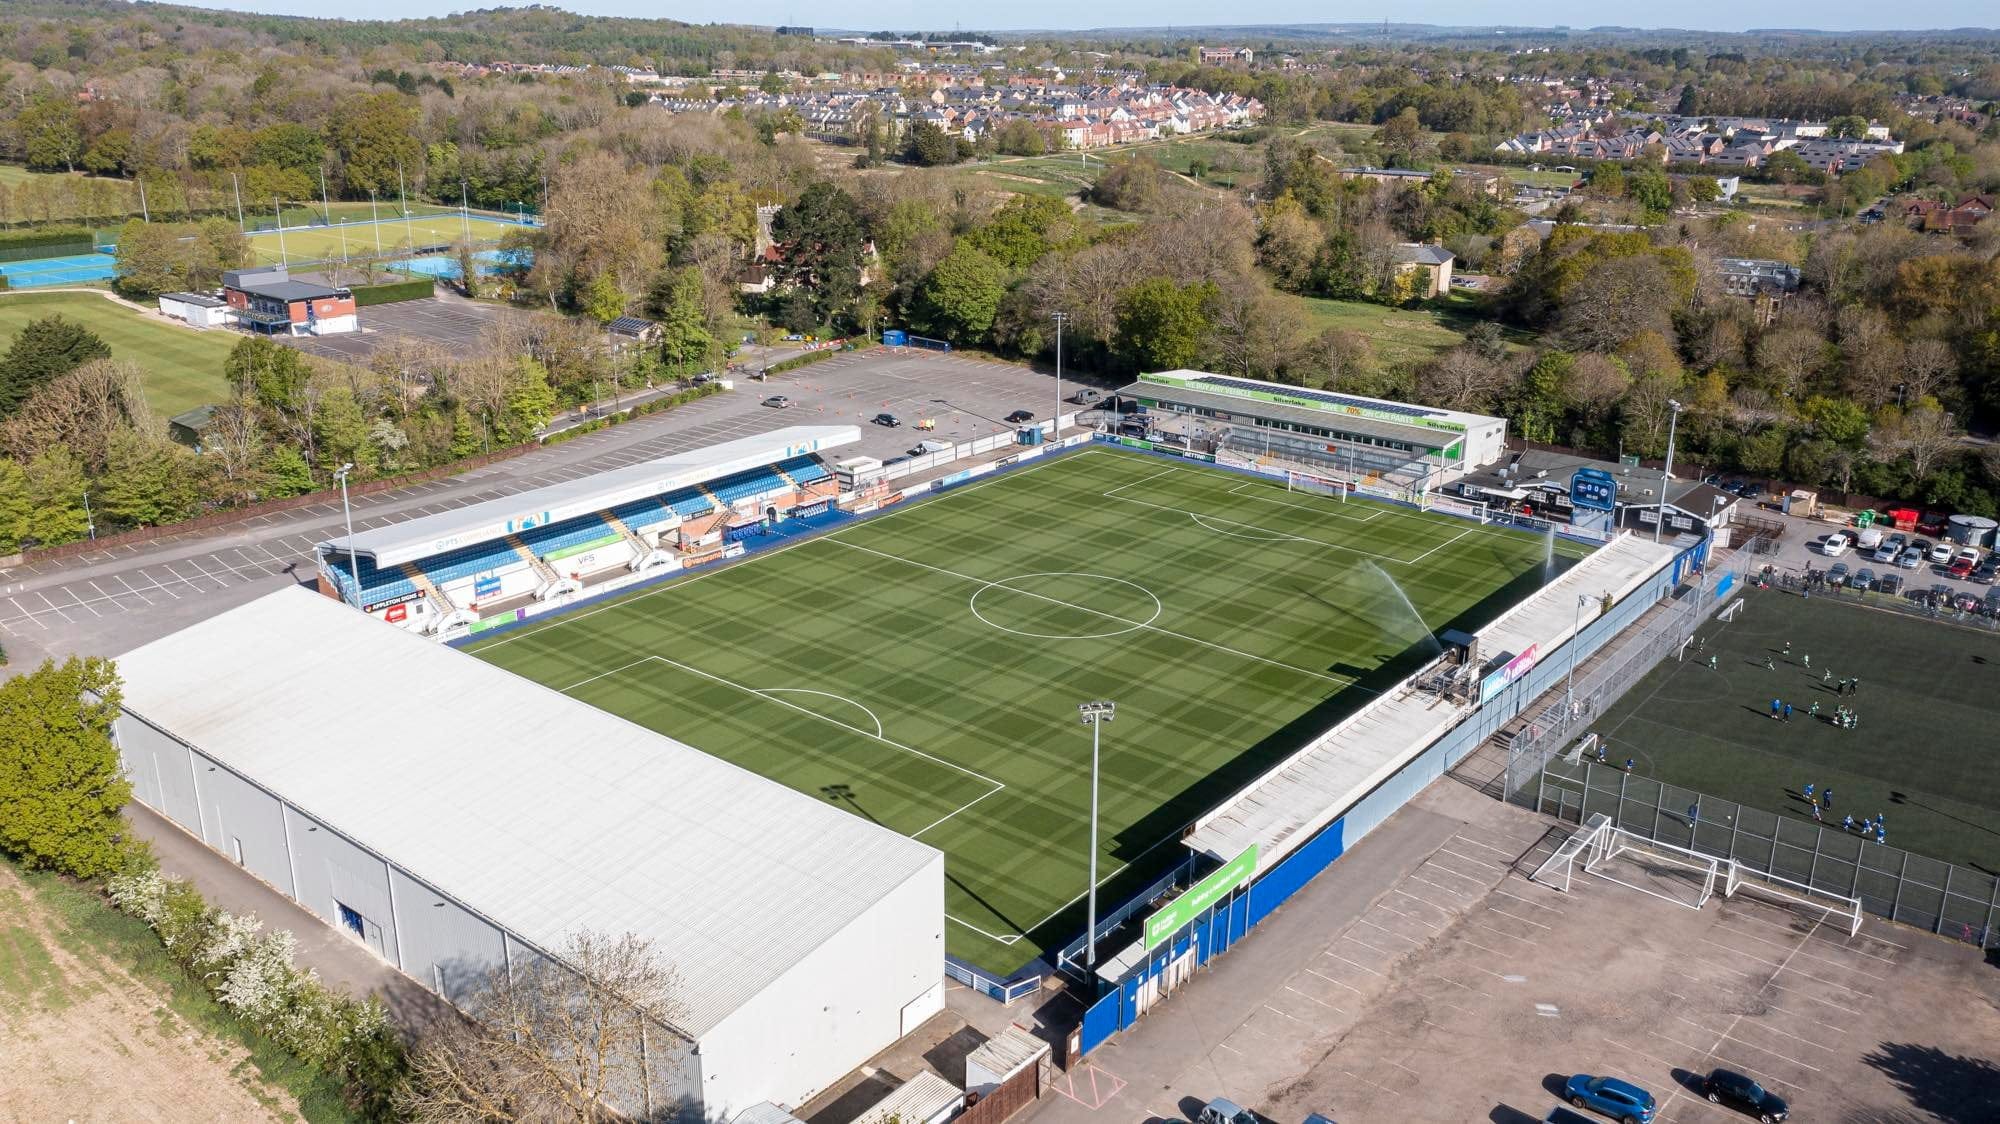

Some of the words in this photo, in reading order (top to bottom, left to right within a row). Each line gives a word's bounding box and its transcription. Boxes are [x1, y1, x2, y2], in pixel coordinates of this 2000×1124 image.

[1140, 375, 1169, 385] Silverlake
[1273, 396, 1306, 407] Silverlake
[1345, 405, 1360, 416] 70%
[1391, 413, 1413, 423] PARTS
[1427, 421, 1465, 432] Silverlake
[372, 598, 401, 610] APPLETON
[401, 593, 418, 603] SIGNS
